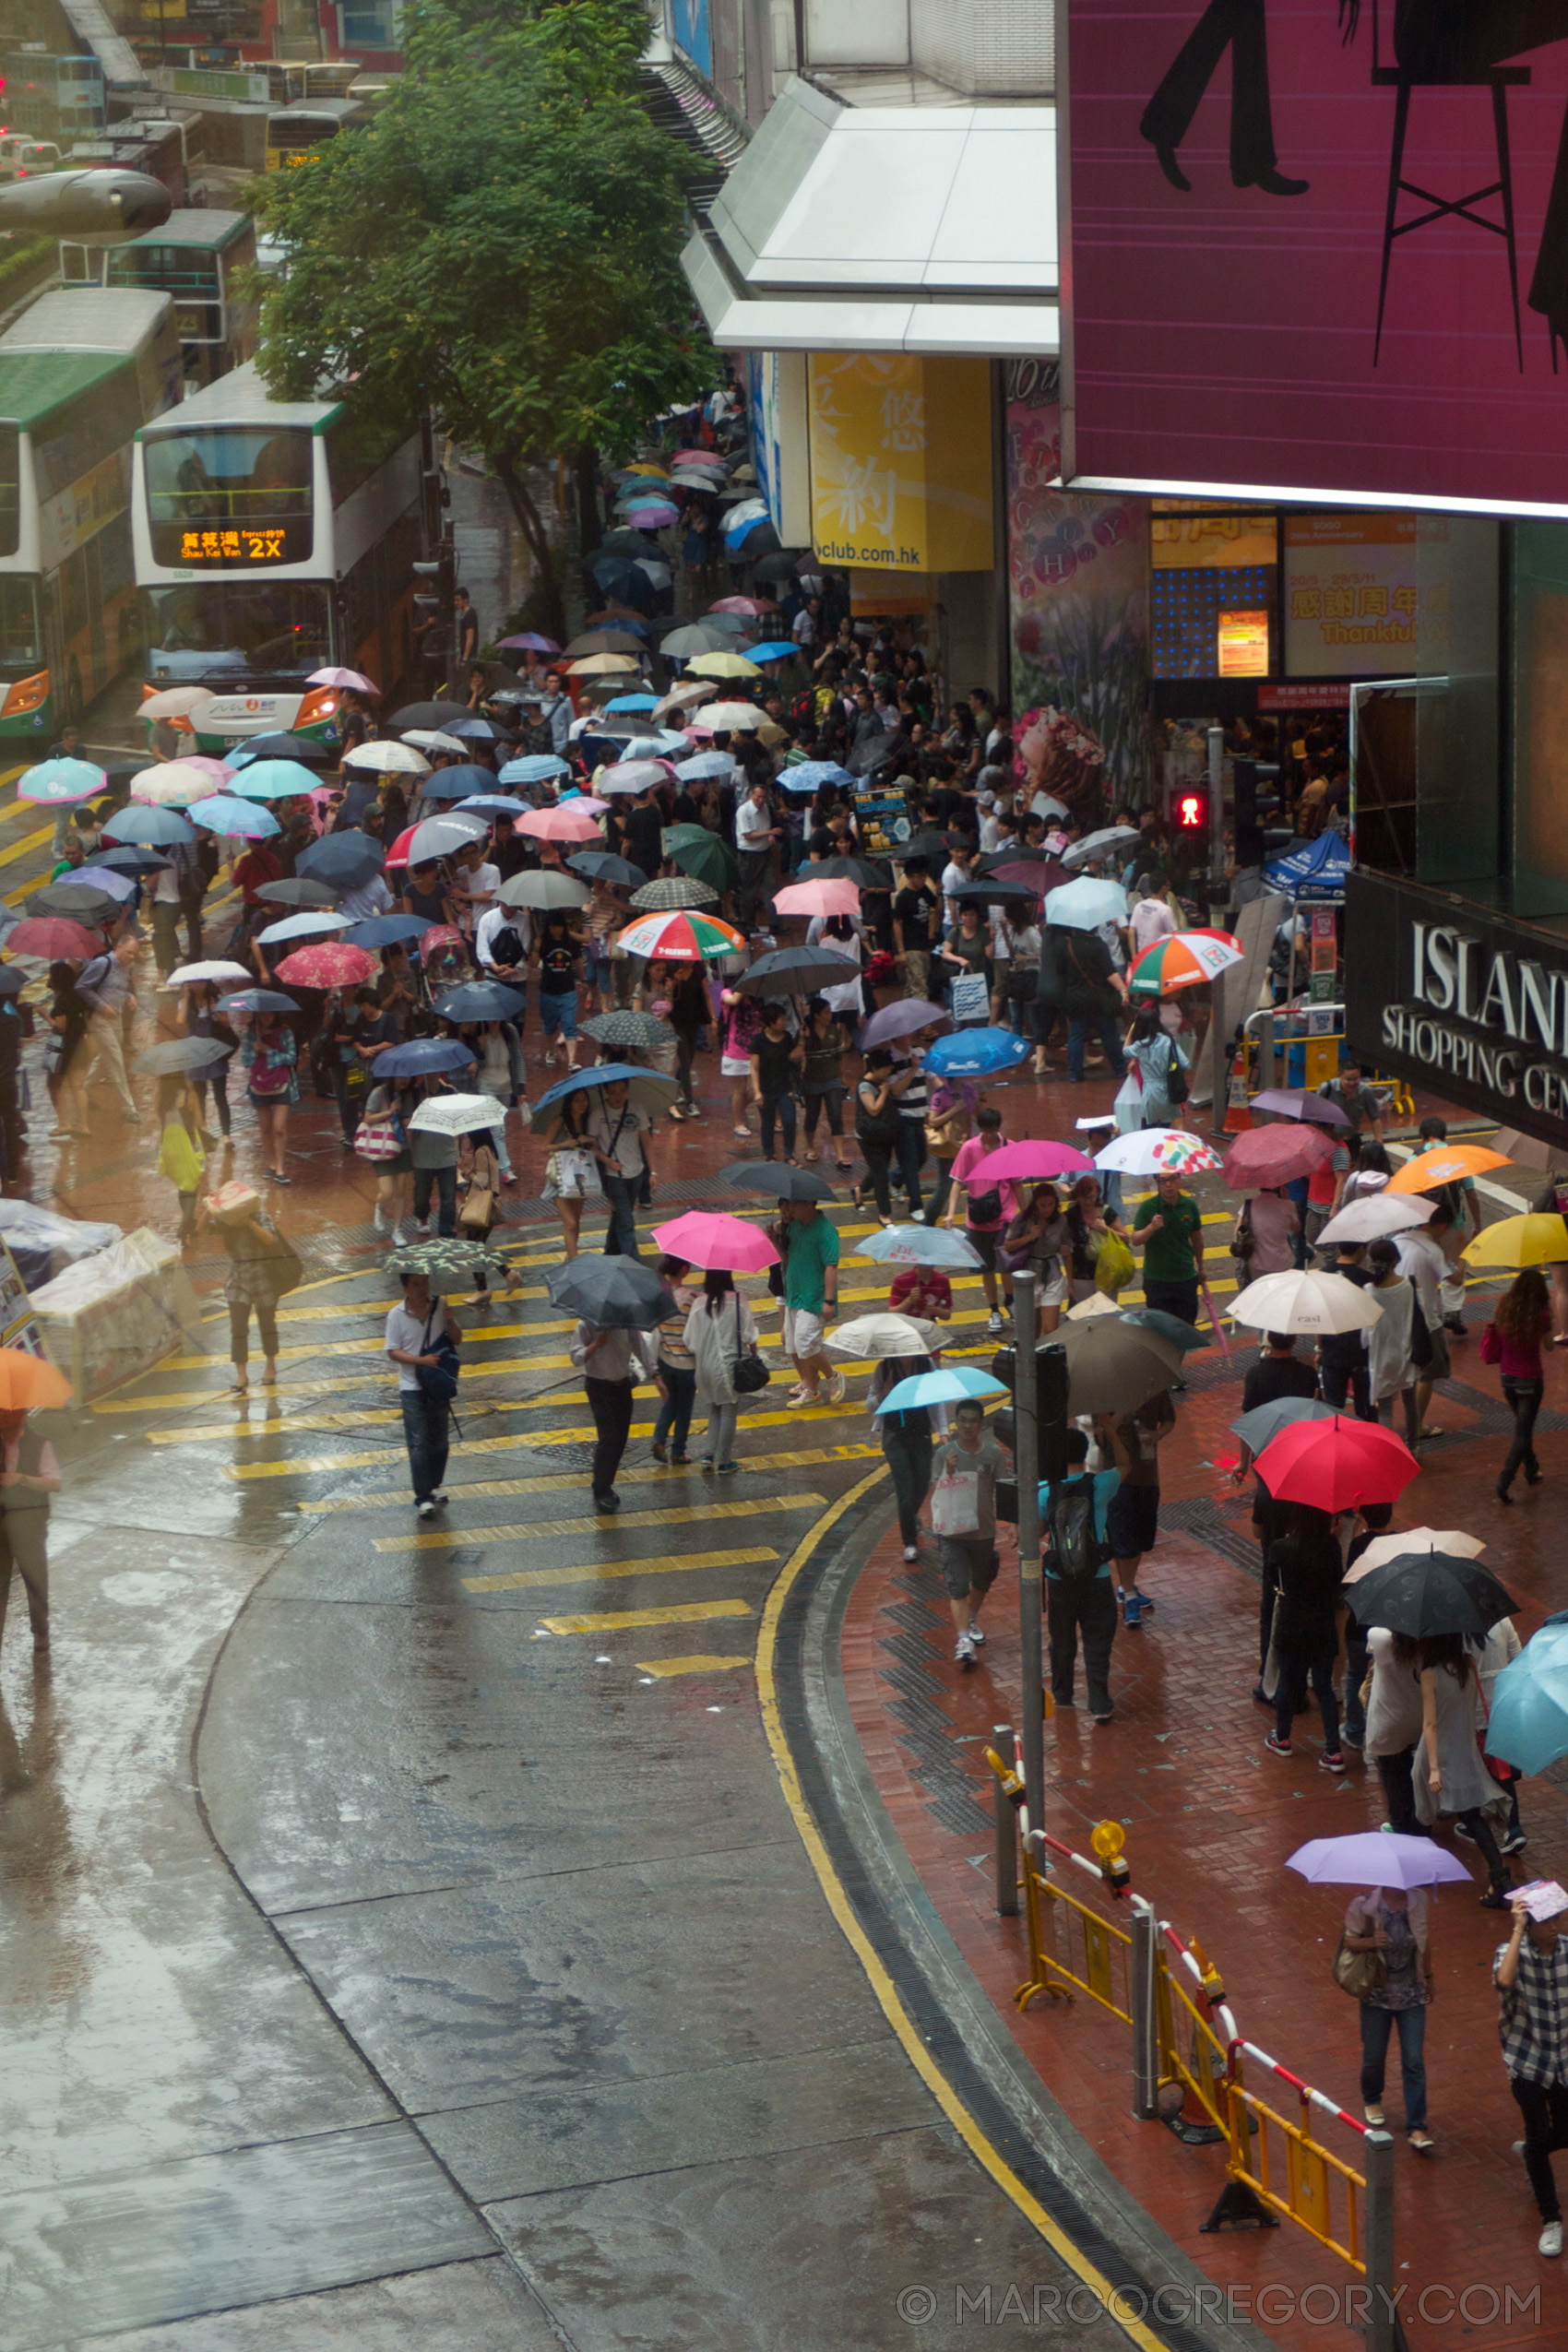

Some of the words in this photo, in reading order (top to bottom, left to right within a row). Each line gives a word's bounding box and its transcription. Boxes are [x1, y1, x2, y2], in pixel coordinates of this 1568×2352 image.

[181, 546, 204, 559] Shau
[206, 546, 221, 558] Kei
[222, 545, 242, 557] Wan
[248, 538, 281, 558] 2X
[856, 797, 906, 814] CASIO
[435, 820, 479, 836] NISSAN
[657, 946, 693, 956] 7-ELEVEN
[702, 942, 731, 954] 7-ELEVEN
[1412, 920, 1568, 1059] ISLAN
[1382, 1004, 1525, 1099] SHOPPING
